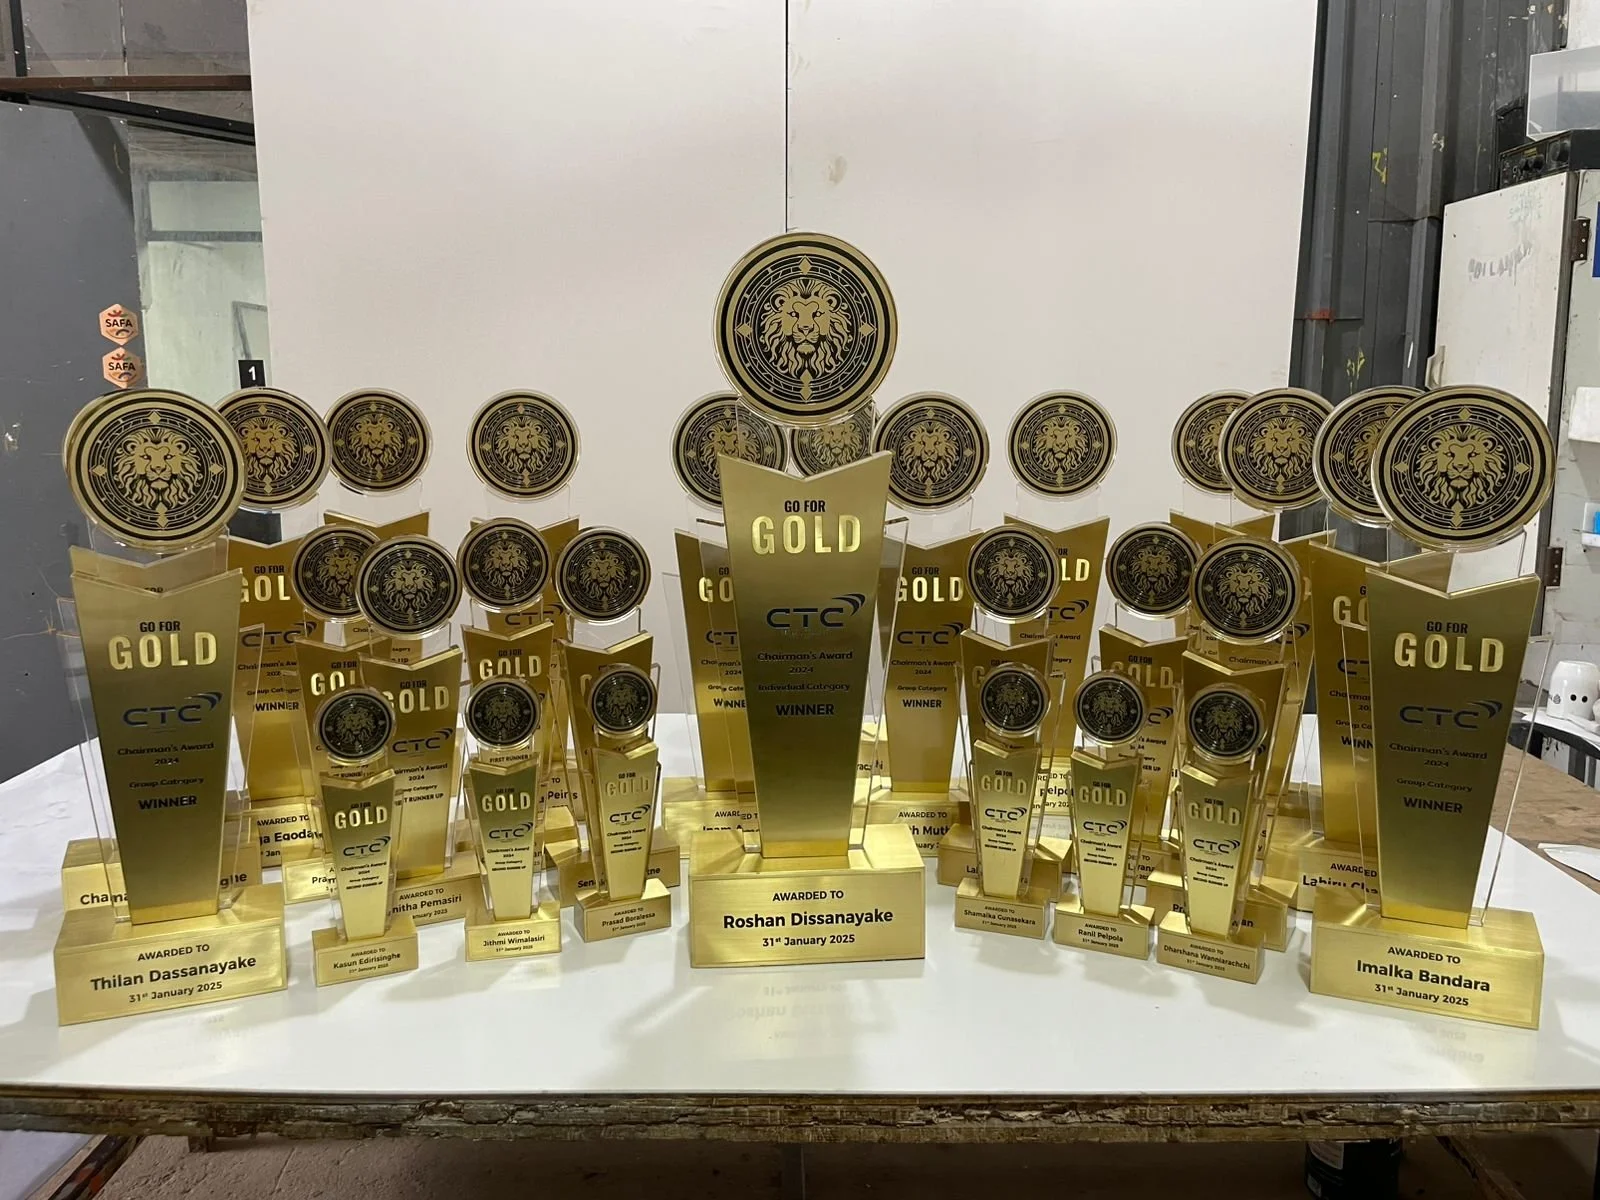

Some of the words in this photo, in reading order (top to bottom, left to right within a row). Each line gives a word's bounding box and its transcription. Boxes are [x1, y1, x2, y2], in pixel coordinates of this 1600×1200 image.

[105, 318, 133, 328] SAFA
[108, 362, 136, 371] SAFA
[248, 365, 256, 381] 1
[784, 500, 801, 513] GO
[804, 500, 826, 513] FOR
[751, 514, 862, 555] GOLD
[254, 565, 267, 575] GO
[268, 565, 285, 574] FOR
[911, 566, 923, 575] GO
[924, 566, 940, 575] FOR
[896, 576, 965, 603] GOLD
[766, 607, 844, 628] CTC
[140, 621, 156, 633] GO
[159, 620, 181, 632] FOR
[1426, 621, 1442, 633] GO
[1446, 622, 1469, 634] FOR
[896, 630, 950, 646] CTC
[107, 631, 217, 671] GOLD
[757, 651, 817, 661] Chairman's
[819, 651, 853, 660] Award
[1394, 632, 1505, 673] GOLD
[789, 666, 814, 674] 2024
[256, 701, 300, 712] WINNER
[775, 703, 835, 716] WINNER
[902, 698, 942, 709] WINNER
[122, 704, 202, 726] CTC
[1399, 705, 1479, 730] CTC
[117, 744, 179, 756] Chairman's
[180, 742, 215, 752] Award
[392, 736, 441, 753] CTC
[1388, 742, 1451, 757] Chairman's
[1452, 749, 1488, 760] Award
[605, 777, 650, 797] GOLD
[981, 774, 1028, 796] GOLD
[1396, 777, 1426, 788] Group
[1427, 780, 1474, 793] Category
[138, 795, 198, 810] WINNER
[481, 791, 532, 813] GOLD
[1079, 785, 1128, 807] GOLD
[1403, 797, 1464, 814] WINNER
[256, 815, 298, 827] AWARDED
[334, 805, 388, 830] GOLD
[609, 810, 642, 823] CTC
[898, 811, 937, 819] AWARDED
[984, 807, 1018, 821] CTC
[1187, 801, 1241, 827] GOLD
[488, 828, 525, 840] CTC
[1083, 820, 1118, 835] CTC
[342, 843, 382, 857] CTC
[1193, 838, 1230, 854] CTC
[398, 888, 434, 901] AWARDED
[420, 894, 462, 909] Pemasiri
[772, 891, 828, 902] AWARDED
[829, 890, 844, 900] TO
[601, 917, 624, 928] Prasad
[723, 912, 786, 929] Roshan
[790, 908, 894, 928] Dissanayake
[997, 914, 1036, 926] Gunasekara
[482, 938, 507, 947] Jithmi
[507, 935, 546, 945] Wimalasiri
[762, 937, 782, 947] 31st
[784, 935, 827, 947] January
[829, 934, 855, 944] 2025
[1078, 928, 1096, 938] Ranil
[1097, 931, 1124, 942] Pelpola
[137, 945, 193, 962] AWARDED
[195, 943, 210, 954] TO
[1163, 944, 1200, 958] Dharshana
[1199, 952, 1251, 970] Wanniarachchi
[1387, 946, 1444, 963] AWARDED
[1446, 954, 1461, 965] TO
[333, 960, 358, 969] Kasun
[358, 953, 401, 966] Edirisinghe
[90, 974, 144, 991] Thilan
[149, 956, 257, 983] Dassanayake
[1356, 959, 1414, 980] Imalka
[1418, 969, 1491, 992] Bandara
[128, 991, 149, 1003] 31st
[150, 986, 195, 1000] January
[197, 981, 223, 993] 2025
[1374, 983, 1395, 994] 31st
[1396, 987, 1440, 1003] January
[1442, 994, 1470, 1007] 2025
